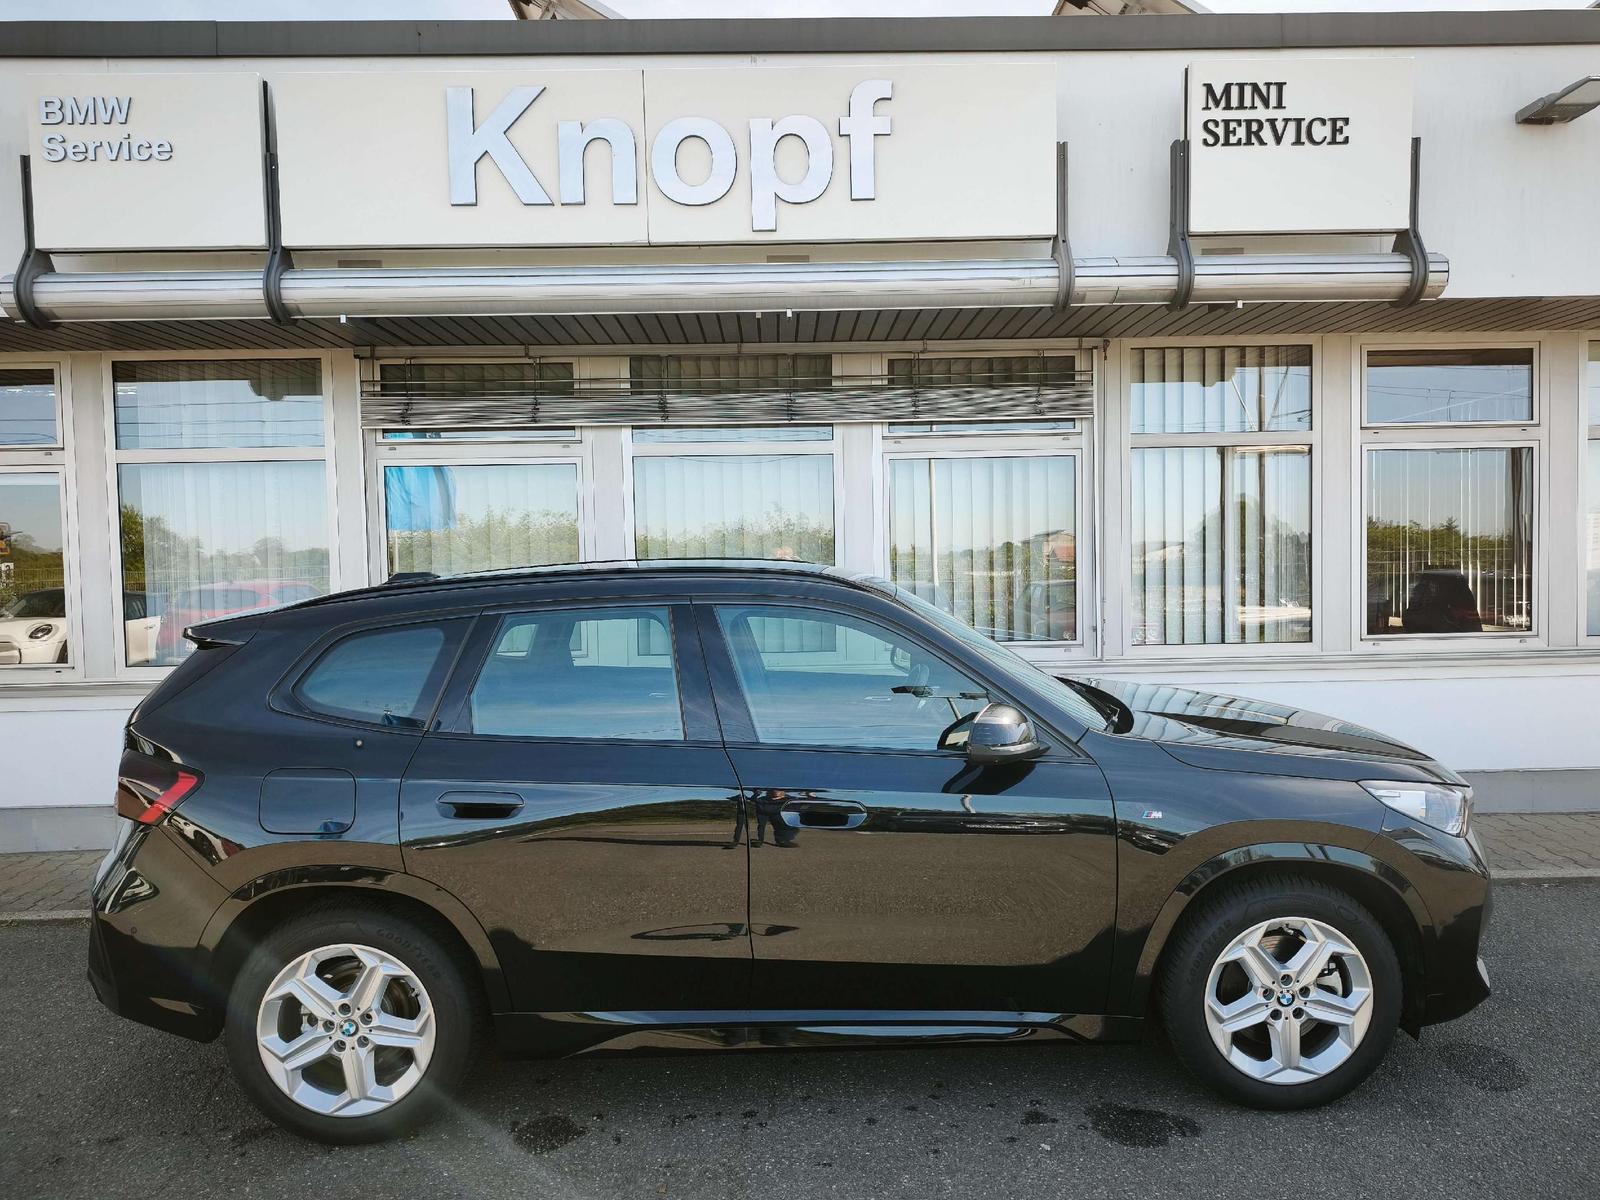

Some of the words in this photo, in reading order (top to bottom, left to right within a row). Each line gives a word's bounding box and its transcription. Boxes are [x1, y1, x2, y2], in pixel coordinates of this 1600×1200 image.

[39, 96, 131, 125] BMW
[1202, 82, 1287, 110] MINI
[1202, 117, 1350, 147] SERVICE
[41, 133, 173, 162] Service
[446, 80, 893, 231] Knopf
